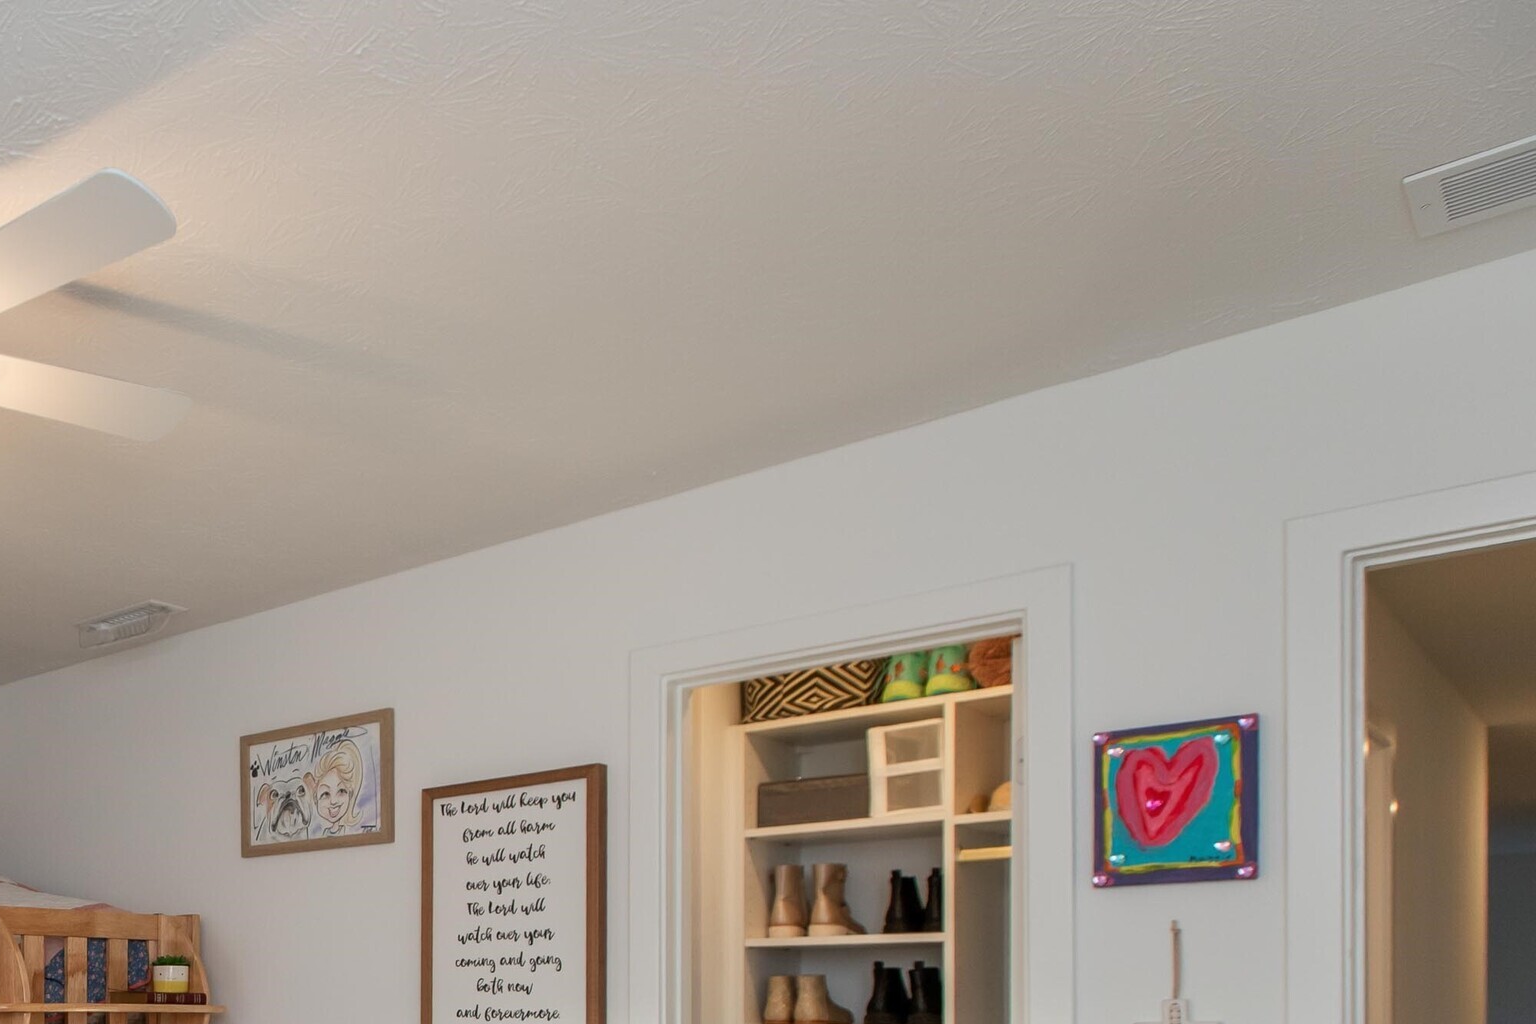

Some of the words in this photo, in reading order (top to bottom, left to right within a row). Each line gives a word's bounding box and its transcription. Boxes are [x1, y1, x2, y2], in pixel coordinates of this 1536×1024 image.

[257, 741, 309, 776] Winston
[440, 803, 457, 817] The
[461, 797, 489, 815] Lord
[492, 794, 516, 814] will
[519, 791, 549, 809] keep
[551, 791, 577, 811] you
[462, 827, 495, 843] from
[497, 820, 517, 836] all
[519, 819, 556, 835] harm
[466, 851, 479, 866] he
[482, 848, 506, 866] will
[508, 843, 546, 864] watch
[466, 879, 490, 892] over
[493, 876, 523, 895] your
[467, 902, 485, 916] The
[488, 899, 518, 916] Lord
[520, 897, 546, 915] will
[457, 925, 492, 945] watch
[496, 929, 521, 942] over
[523, 927, 556, 946] your
[455, 956, 496, 974] coming
[499, 951, 526, 967] and
[529, 955, 562, 973] going
[476, 976, 504, 995] both
[507, 981, 534, 995] now
[456, 1004, 481, 1020] and
